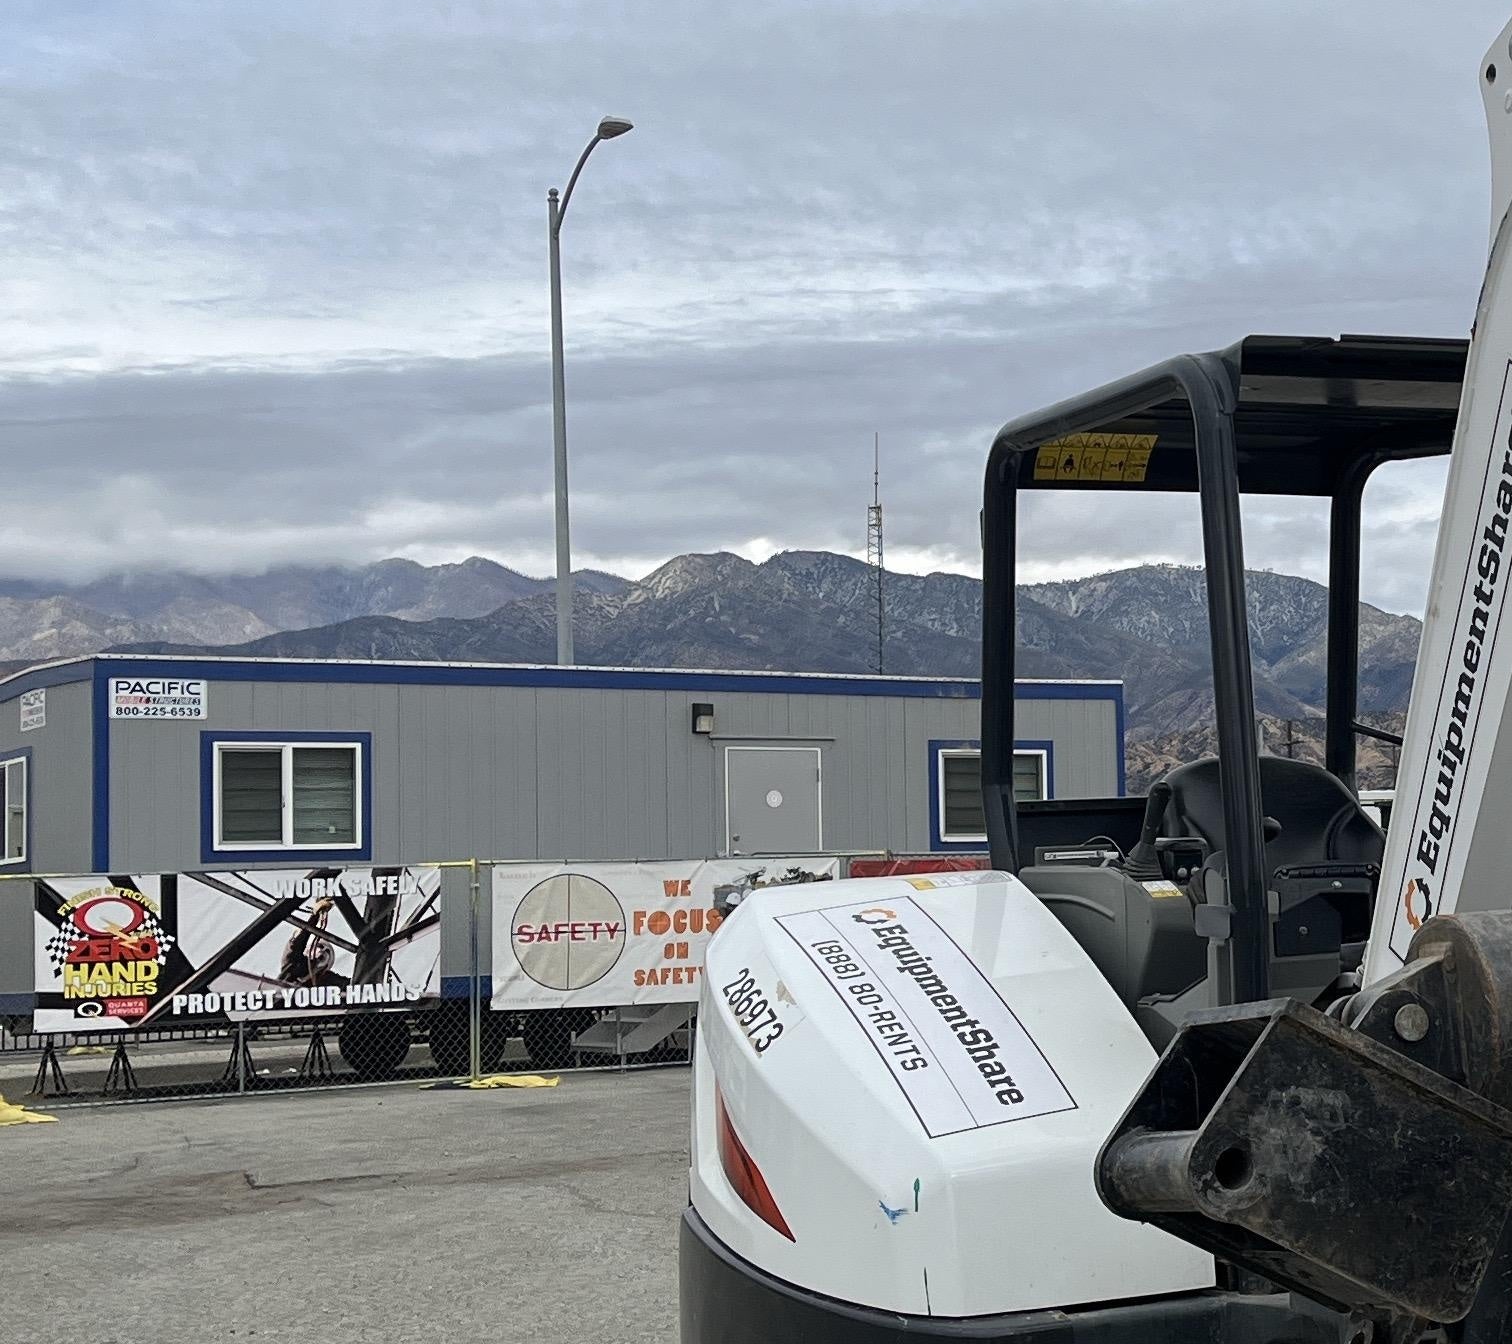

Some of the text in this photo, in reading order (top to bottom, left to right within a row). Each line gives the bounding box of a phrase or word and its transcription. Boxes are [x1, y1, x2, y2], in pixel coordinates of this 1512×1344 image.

[115, 680, 201, 695] PACIFIC
[115, 706, 201, 716] 800-225-6539
[273, 875, 420, 899] WORK SAFELY
[663, 879, 692, 897] WE
[516, 921, 620, 944] SAFETY
[633, 908, 723, 936] FOCUS
[65, 937, 158, 962] ZERO
[664, 942, 689, 959] ON
[64, 960, 160, 985] HAND
[64, 981, 159, 1000] INJURIES
[172, 982, 421, 1015] PROTECT YOUR HANDS
[721, 967, 785, 1054] 286973
[810, 938, 929, 1074] (888) 80-RENTS
[871, 923, 1026, 1107] EquipmentShare
